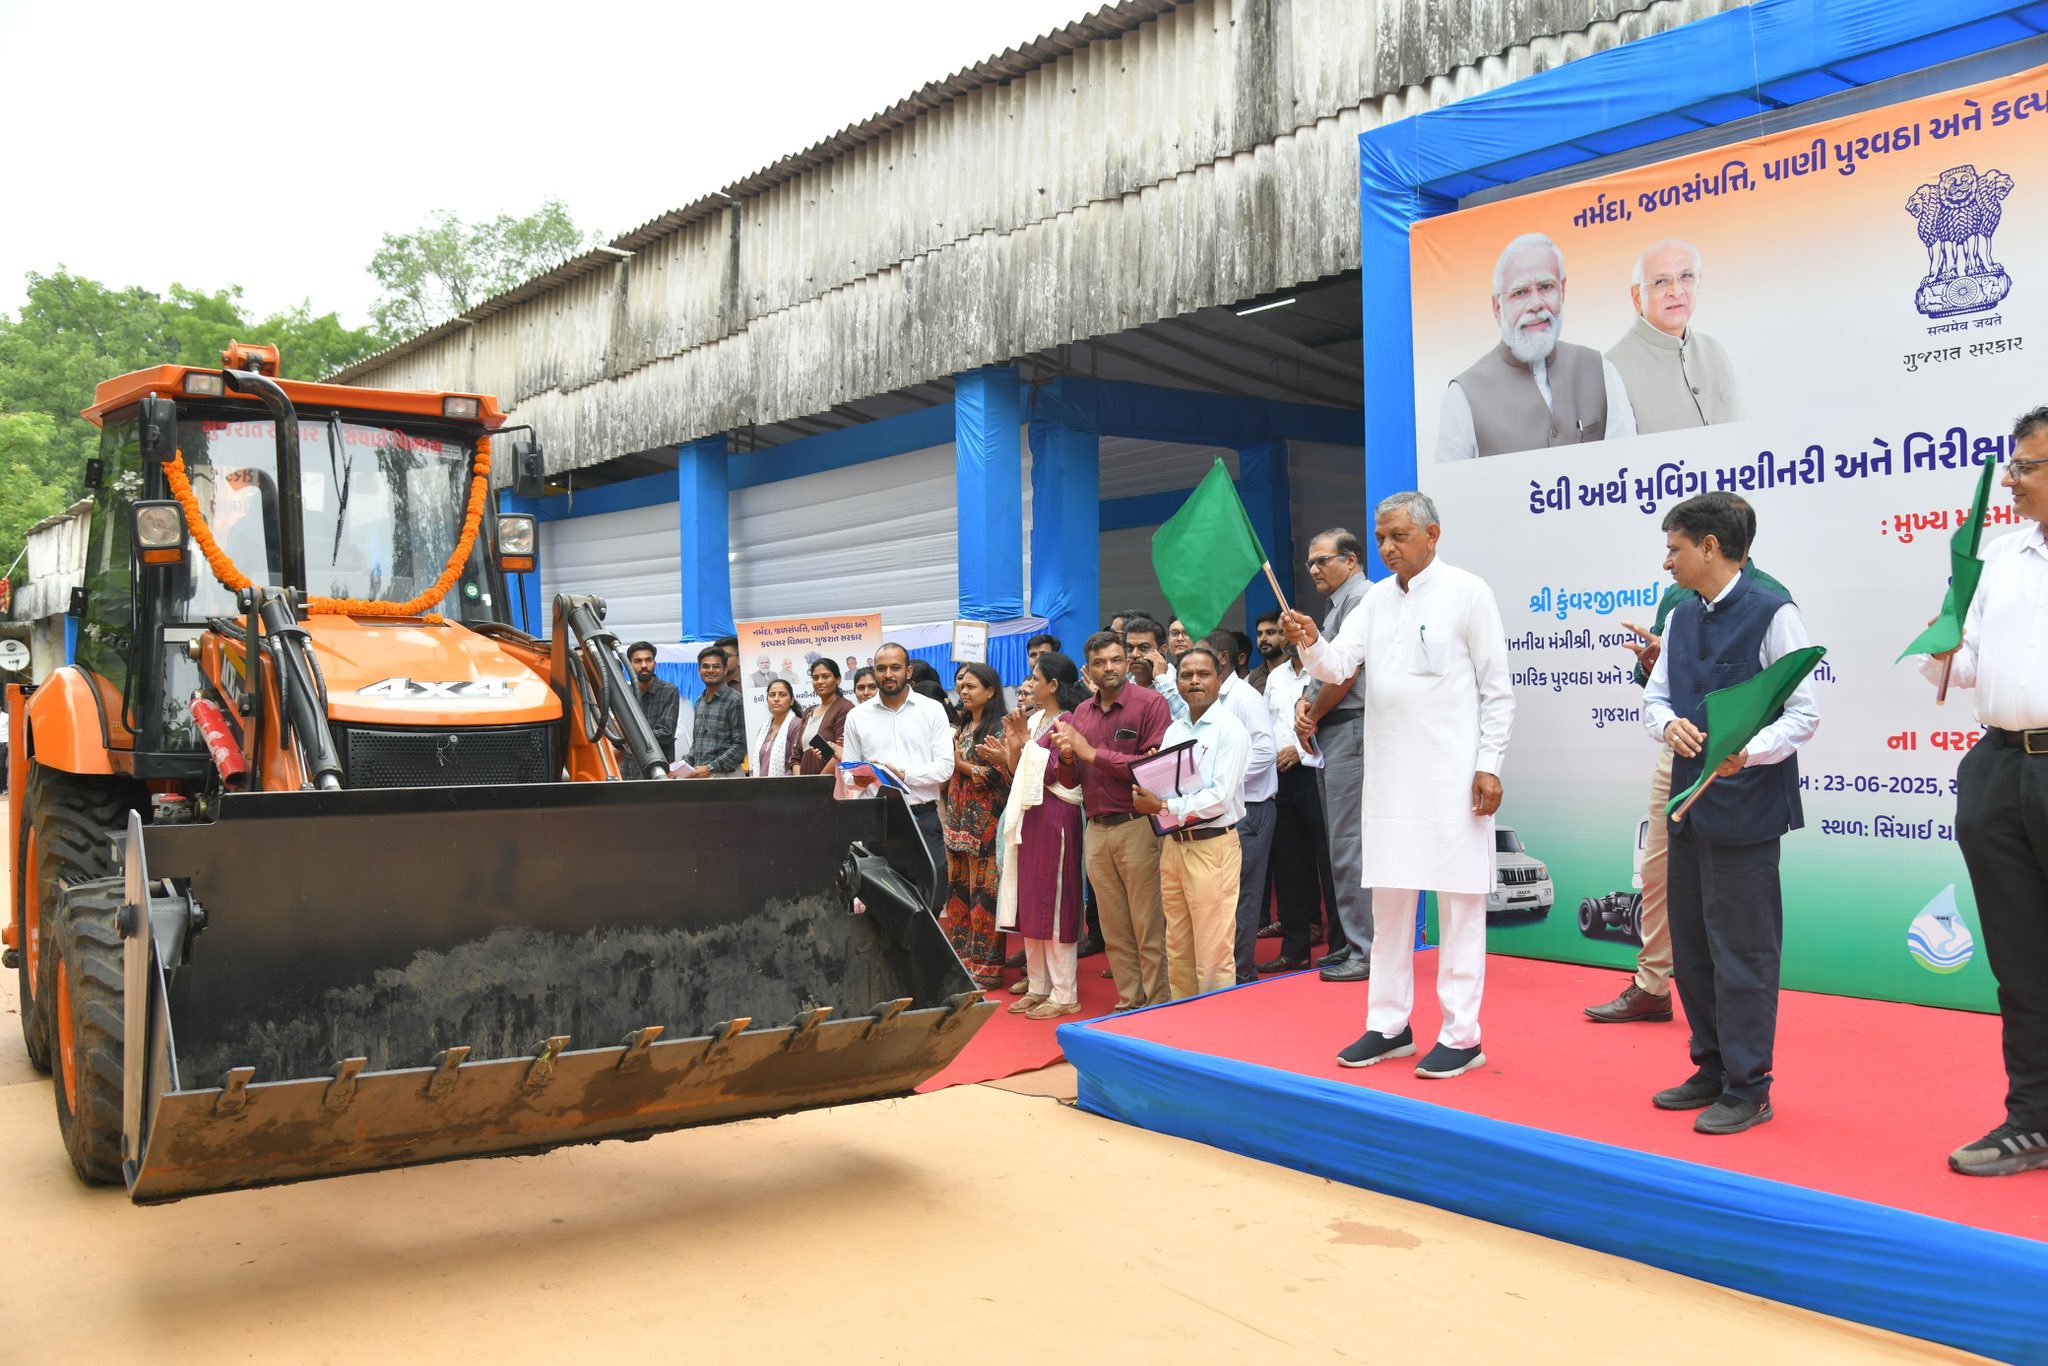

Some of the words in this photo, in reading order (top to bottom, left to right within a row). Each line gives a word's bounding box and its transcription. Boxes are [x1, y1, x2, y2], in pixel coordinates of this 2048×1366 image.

[1573, 194, 1632, 228] નર્મદા,
[1638, 160, 1756, 213] જળસંપત્તિ,
[1763, 138, 1826, 181] પાણી
[1834, 123, 1920, 176] પુરવઠા
[1929, 99, 1981, 140] અને
[1927, 320, 1969, 336] सत्यमेव
[1972, 313, 2002, 329] जयते
[1903, 347, 1961, 372] ગુજરાત
[1969, 337, 2023, 357] સરકાર
[1529, 475, 1571, 514] હેવી
[1578, 467, 1628, 507] અર્થ
[1635, 460, 1706, 514] મુવિંગ
[1716, 444, 1825, 492] મશીનરી
[1834, 437, 1892, 479] અને
[1893, 511, 1948, 544] મુખ્ય
[1529, 586, 1551, 613] શ્રી
[1555, 581, 1659, 621] કુંવરજીભાઈ
[811, 621, 829, 631] પાણી
[831, 621, 853, 634] પુરવઠા
[855, 619, 868, 628] અને
[815, 634, 839, 647] ગુજરાત
[841, 633, 862, 642] સરકાર
[1505, 631, 1545, 651] ાનનીય
[1548, 629, 1595, 650] મંત્રીશ્રી,
[1509, 667, 1547, 686] ાગરિક
[1551, 671, 1593, 692] પુરવઠા
[1597, 664, 1622, 685] અને
[1592, 707, 1640, 729] ગુજરાત
[1887, 731, 1917, 751] ના
[1823, 775, 1943, 797] 23-06-2025,
[1821, 819, 1869, 837] સ્થળ:
[1875, 815, 1933, 840] સિંચાઈ
